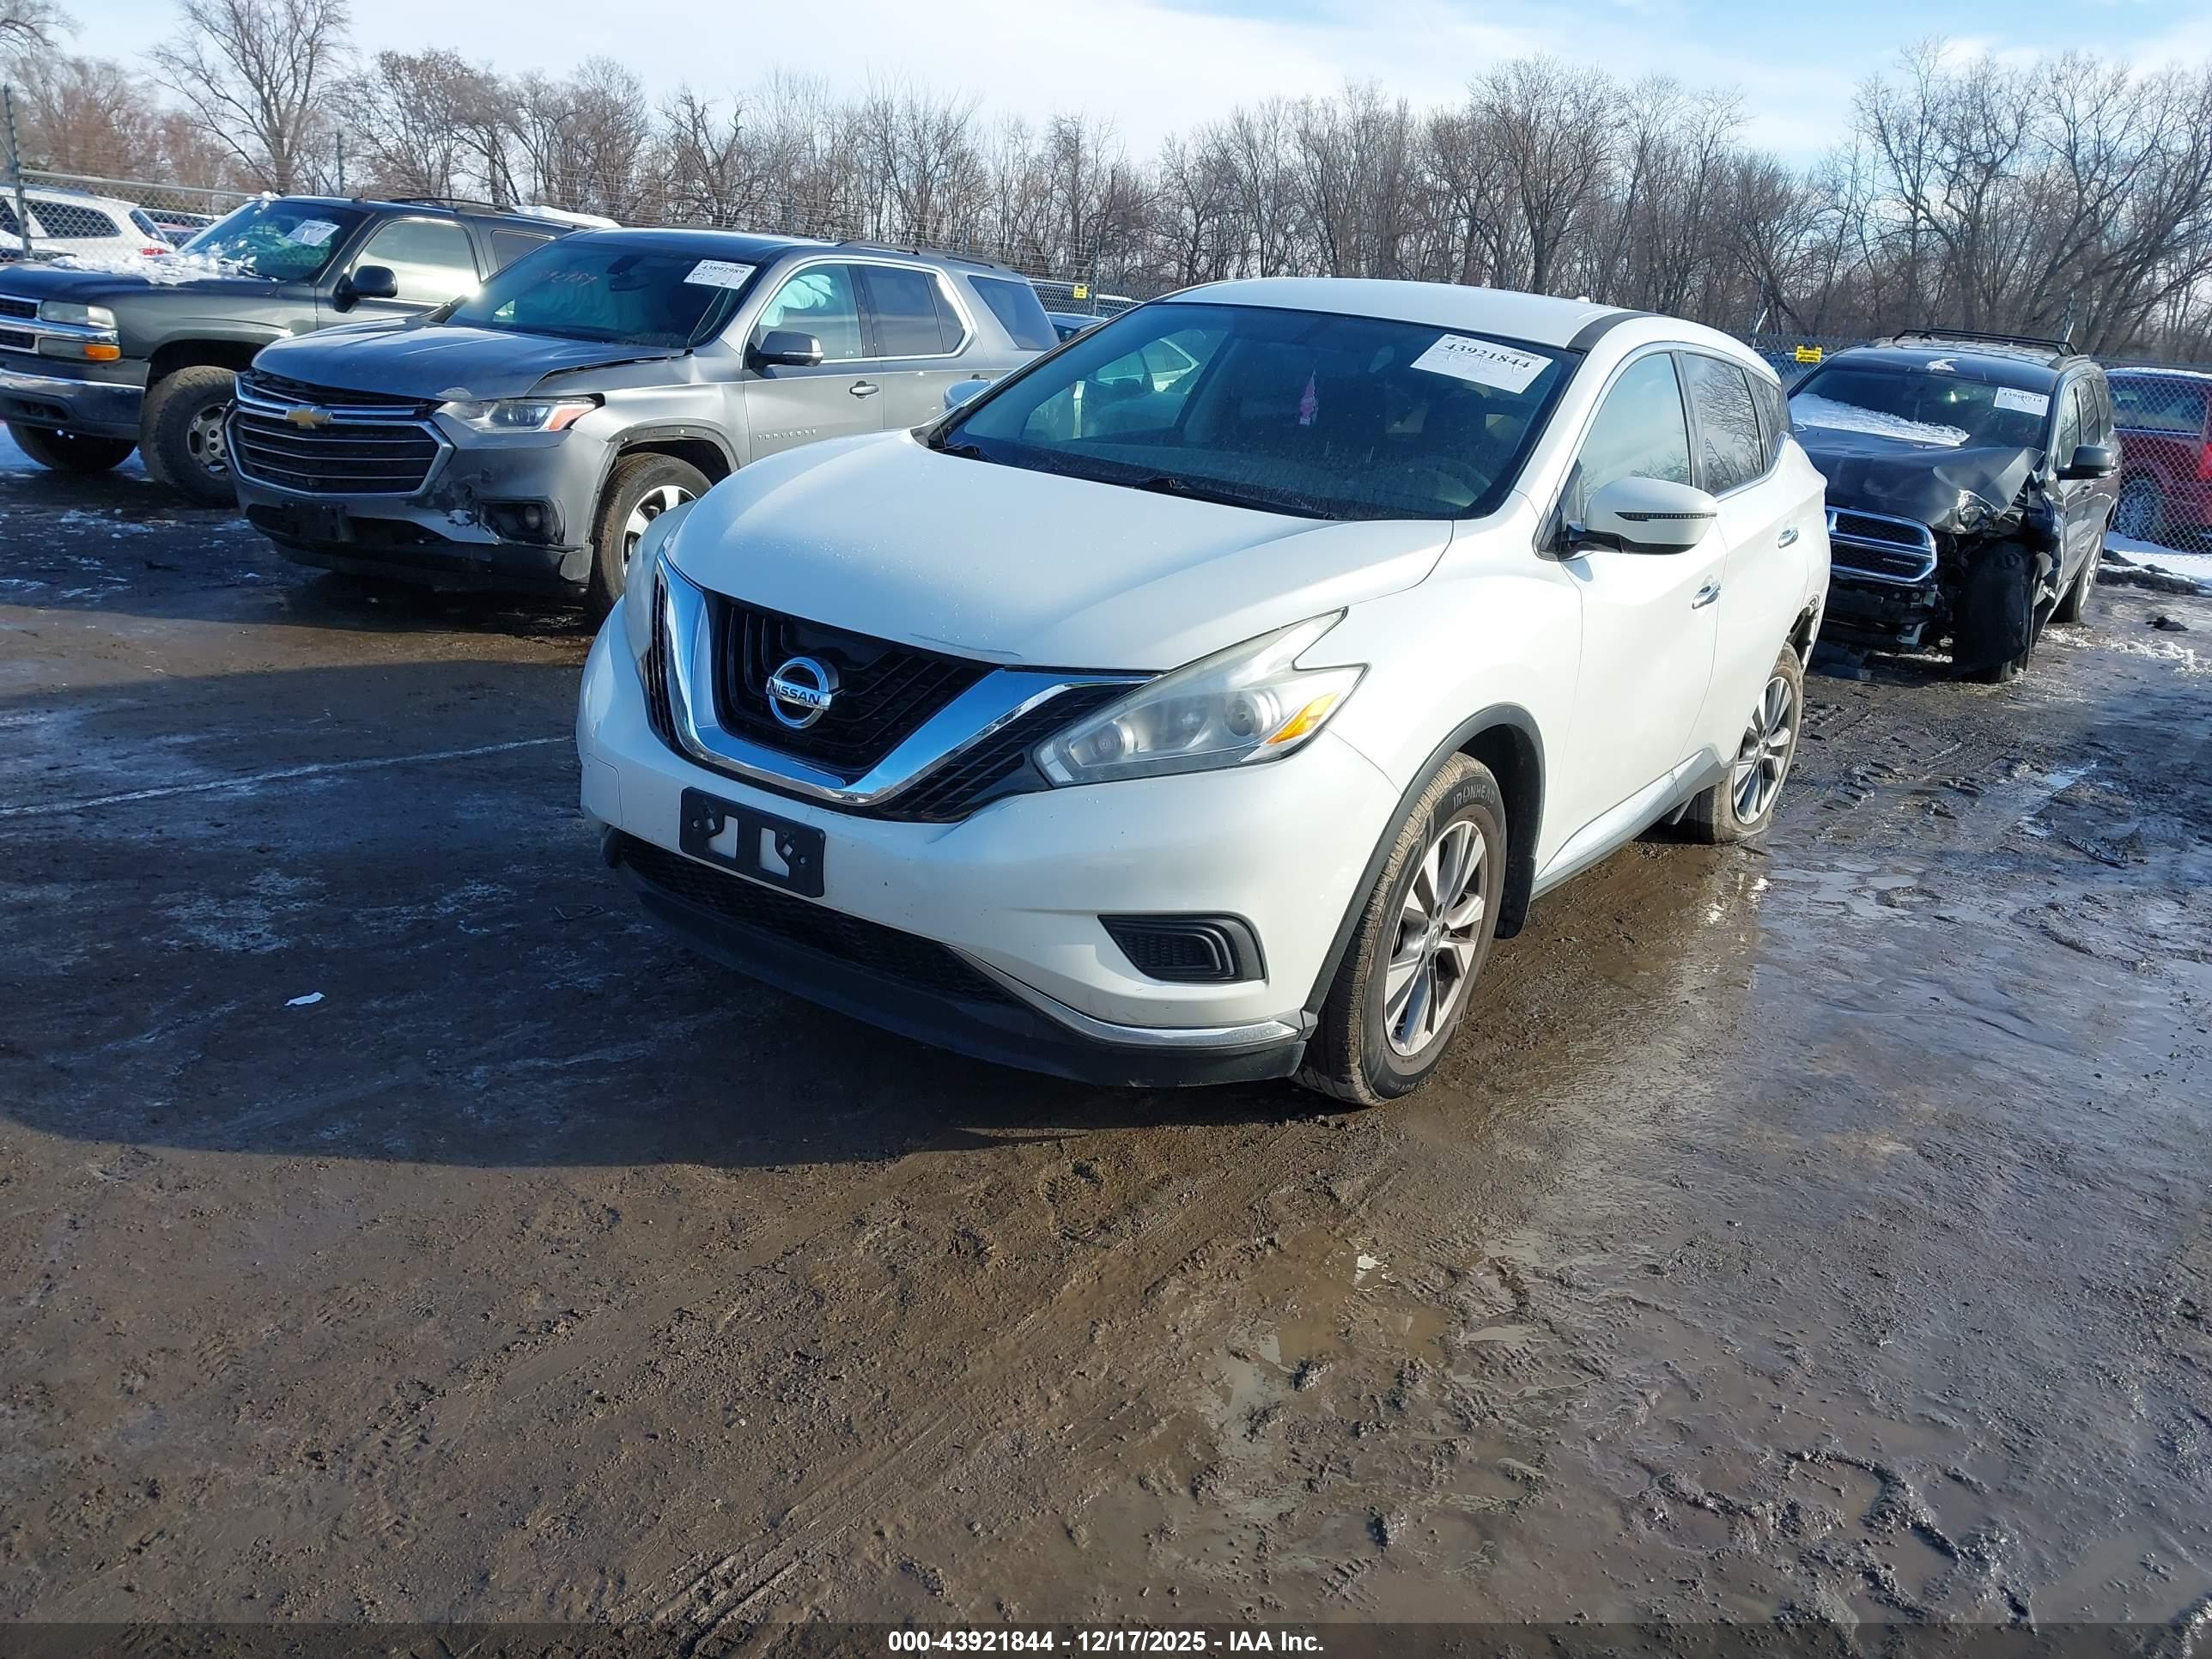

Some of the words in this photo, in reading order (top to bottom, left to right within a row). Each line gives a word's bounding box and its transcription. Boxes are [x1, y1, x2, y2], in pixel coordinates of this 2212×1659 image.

[1443, 343, 1532, 368] 43921844
[769, 678, 821, 705] NISSAN
[1453, 782, 1496, 810] IRONHEAD
